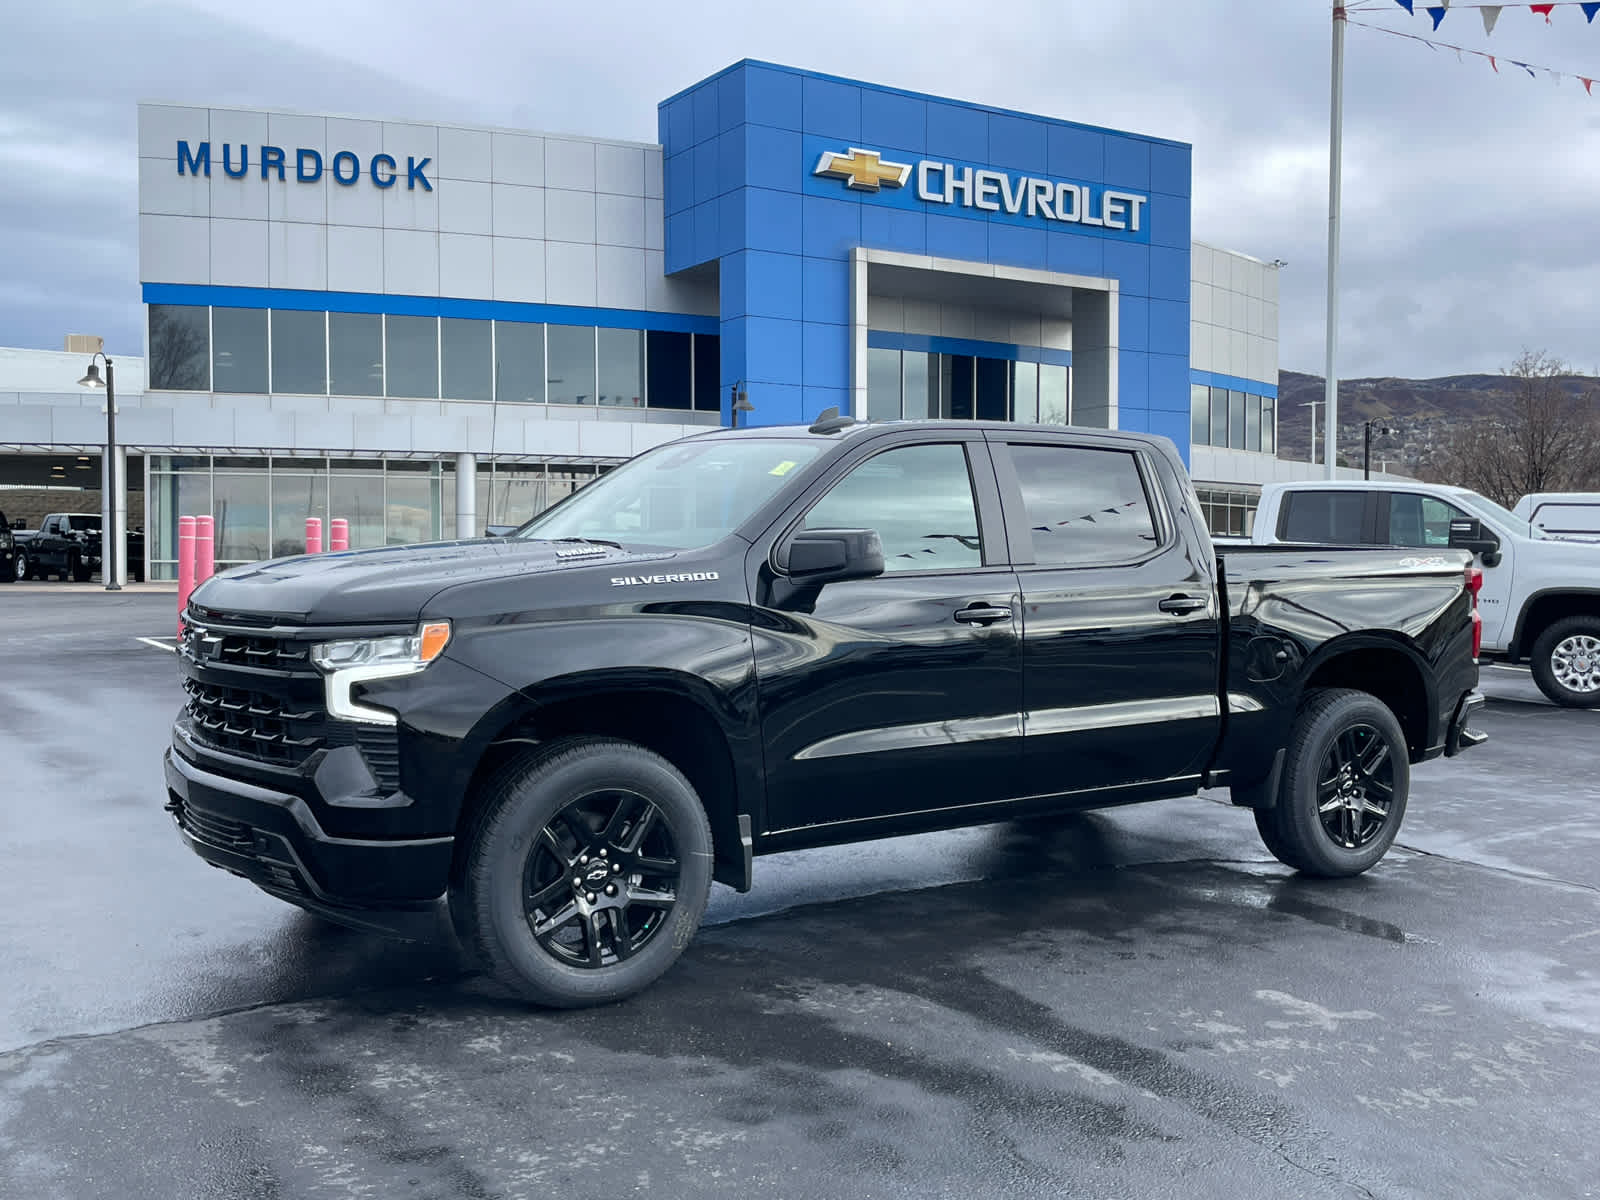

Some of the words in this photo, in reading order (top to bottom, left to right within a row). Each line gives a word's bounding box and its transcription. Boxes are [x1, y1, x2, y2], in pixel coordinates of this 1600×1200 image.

[176, 139, 434, 192] MURDOCK
[917, 160, 1147, 232] CHEVROLET
[610, 571, 720, 587] SILVERADO
